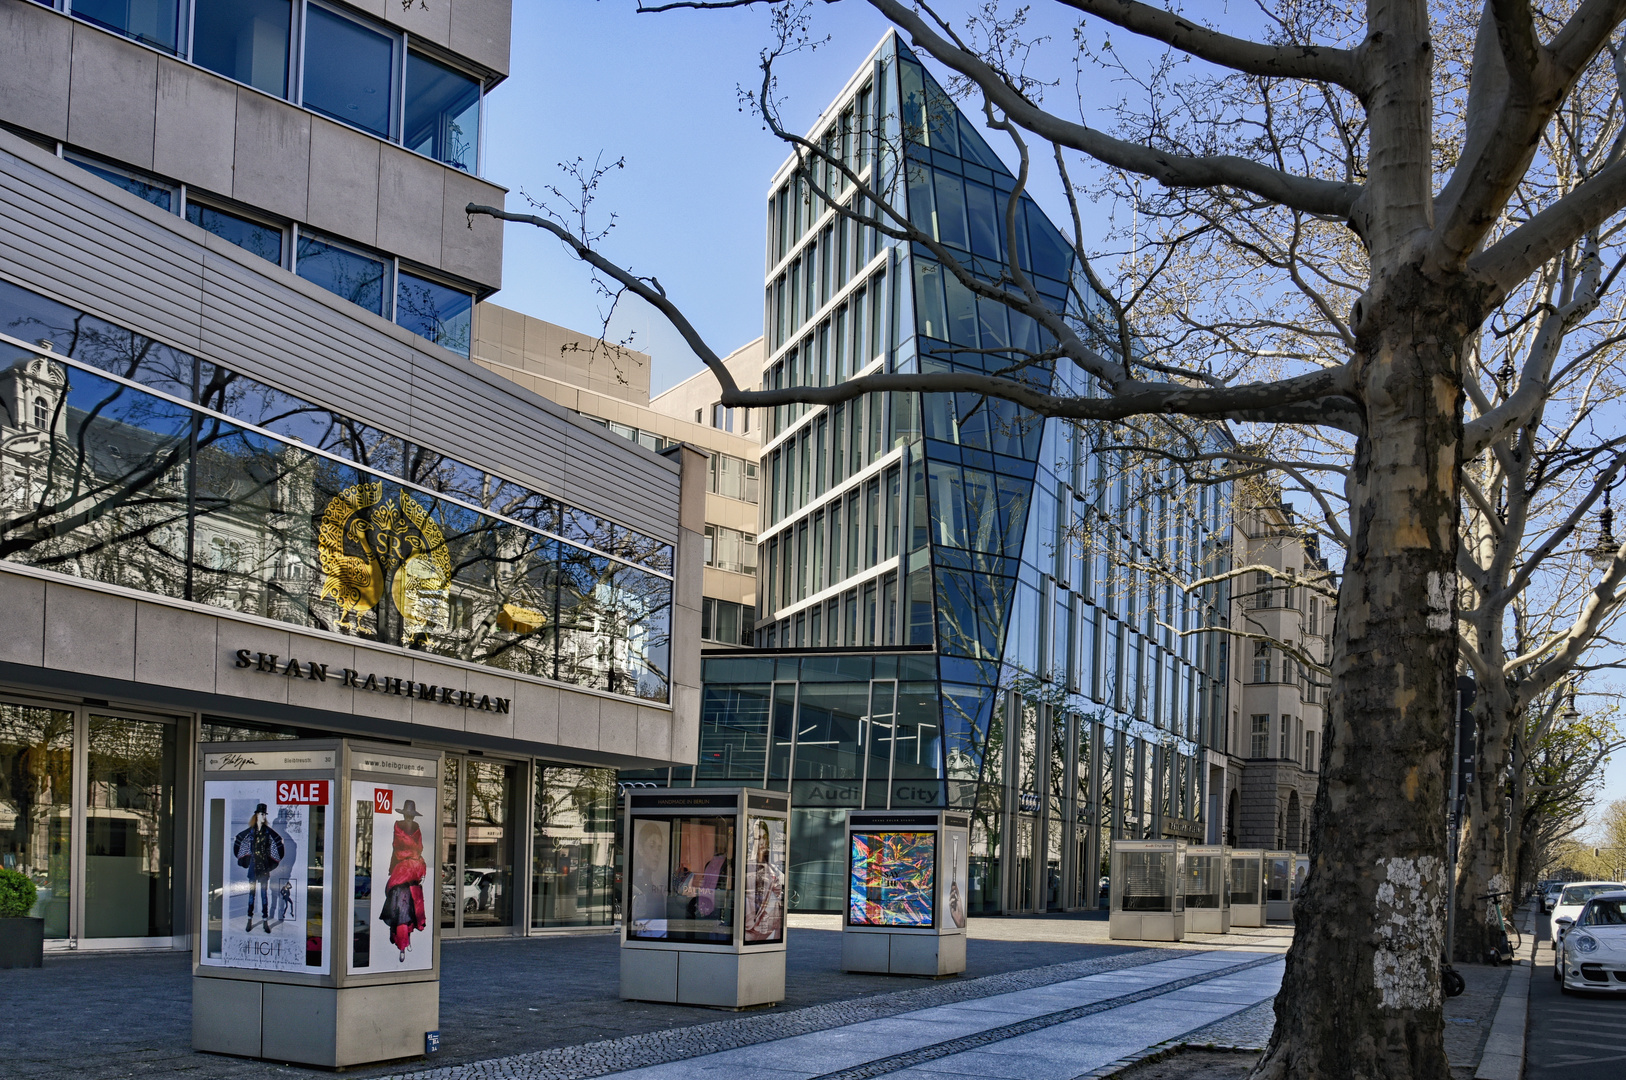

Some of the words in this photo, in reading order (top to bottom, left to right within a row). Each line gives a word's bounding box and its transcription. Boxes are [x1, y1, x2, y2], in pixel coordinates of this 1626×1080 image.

[376, 532, 405, 560] SR
[236, 649, 328, 682] SHAN
[343, 668, 511, 714] RAHIMKHAN
[364, 759, 425, 771] www.bleibgruen.de
[279, 783, 320, 802] SALE
[376, 791, 391, 811] %
[808, 786, 859, 800] Audi
[896, 786, 940, 803] City
[683, 886, 712, 895] PALMA
